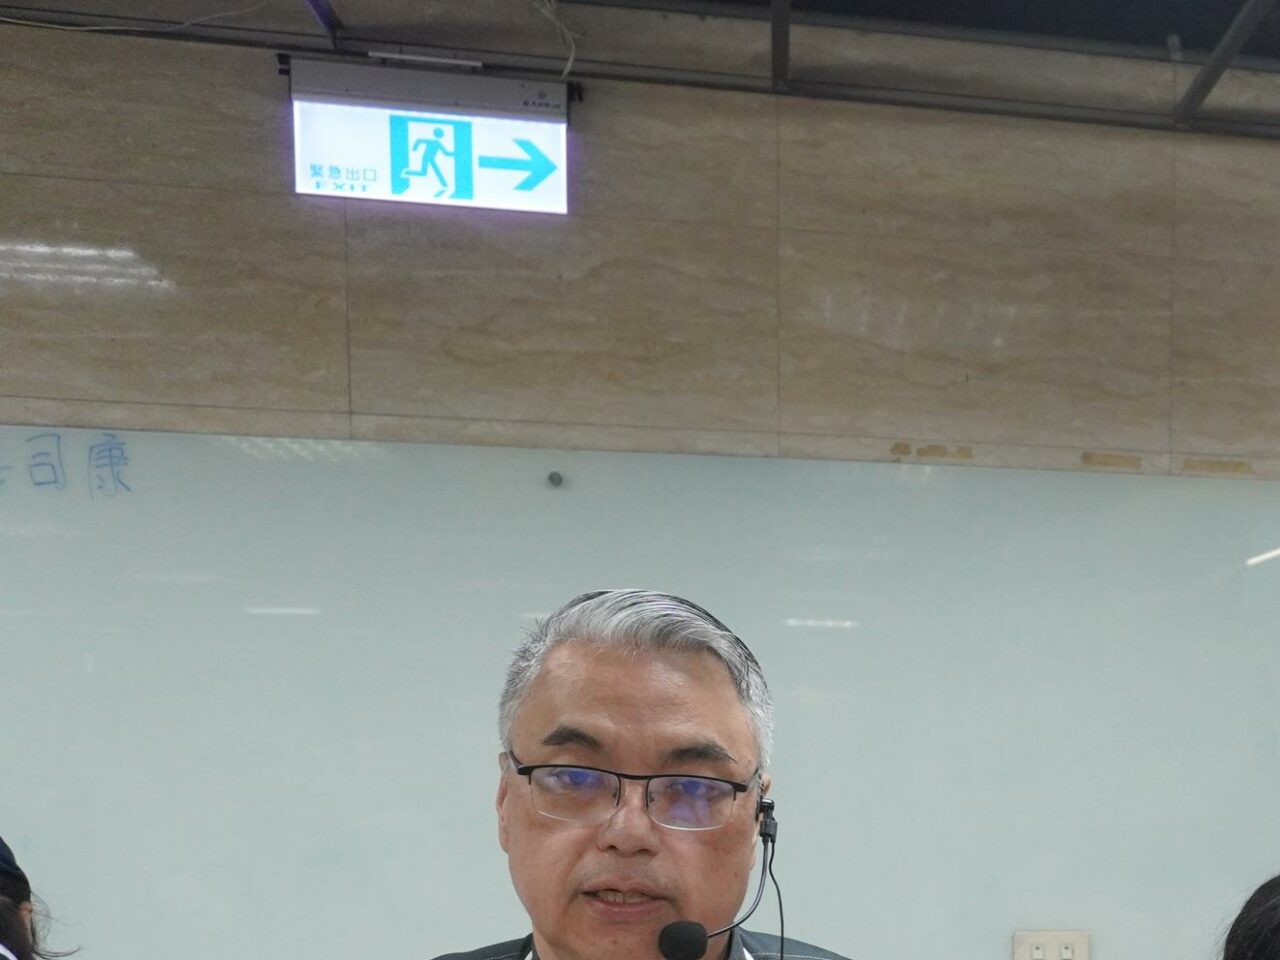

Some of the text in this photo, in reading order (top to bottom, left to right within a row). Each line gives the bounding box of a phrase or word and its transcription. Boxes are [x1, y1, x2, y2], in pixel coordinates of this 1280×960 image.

[310, 163, 377, 182] 緊急出口
[314, 181, 370, 193] EXIT
